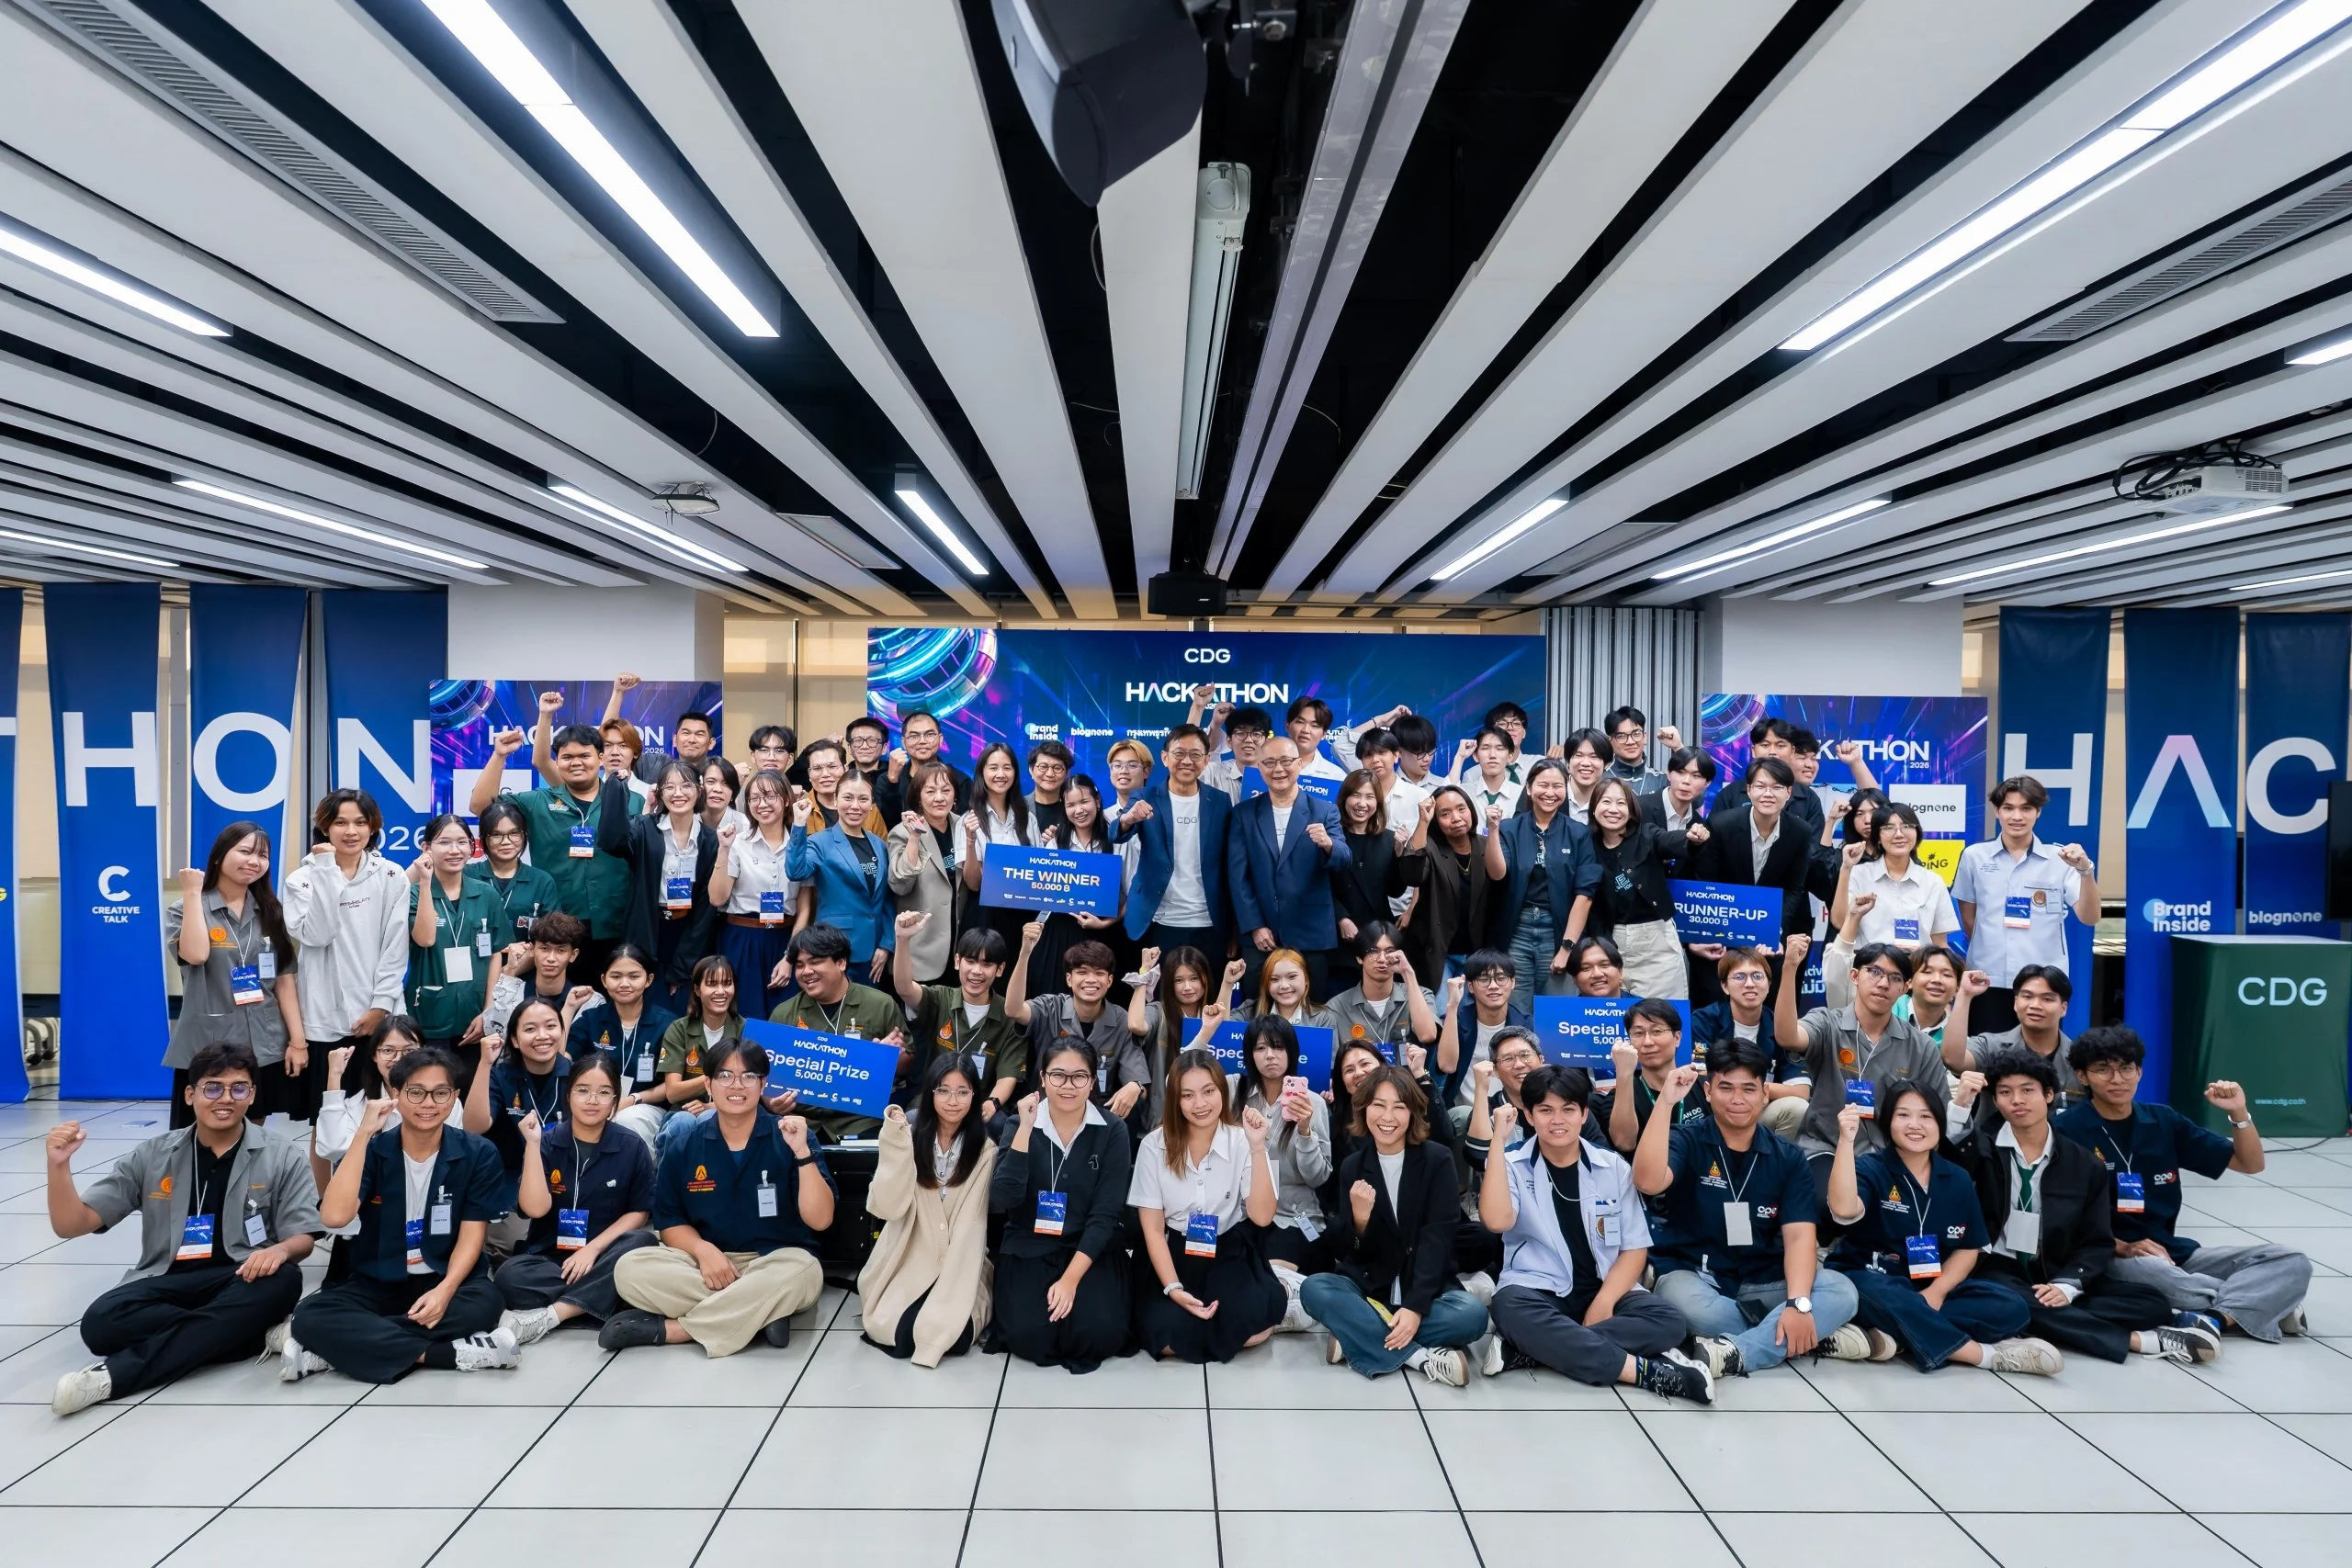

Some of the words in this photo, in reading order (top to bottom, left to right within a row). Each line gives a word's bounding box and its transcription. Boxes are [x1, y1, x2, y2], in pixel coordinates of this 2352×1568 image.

[1184, 648, 1231, 663] CDG
[1029, 724, 1058, 732] Brand
[1070, 728, 1114, 738] blognone
[1298, 784, 1329, 795] KATHON
[1176, 817, 1198, 825] CDG
[1029, 857, 1077, 867] HACKATHON
[1002, 867, 1035, 881] THE
[1038, 870, 1101, 886] WINNER
[1031, 882, 1062, 891] 50,000
[1686, 891, 1735, 901] HACKATHON
[92, 906, 141, 915] CREATIVE
[1674, 902, 1768, 921] RUNNER-UP
[2153, 900, 2211, 916] Brand
[102, 915, 129, 923] TALK
[1689, 915, 1721, 925] 30,000
[2153, 917, 2211, 932] Inside
[2248, 910, 2323, 926] blognone
[2237, 976, 2328, 1006] CDG
[1585, 1009, 1625, 1017] HACKATH
[1558, 1021, 1620, 1036] Special
[793, 1039, 848, 1056] HACKATHON
[1207, 1044, 1244, 1059] Spec
[765, 1049, 825, 1072] Special
[828, 1062, 870, 1080] Prize
[795, 1068, 824, 1082] 5,000
